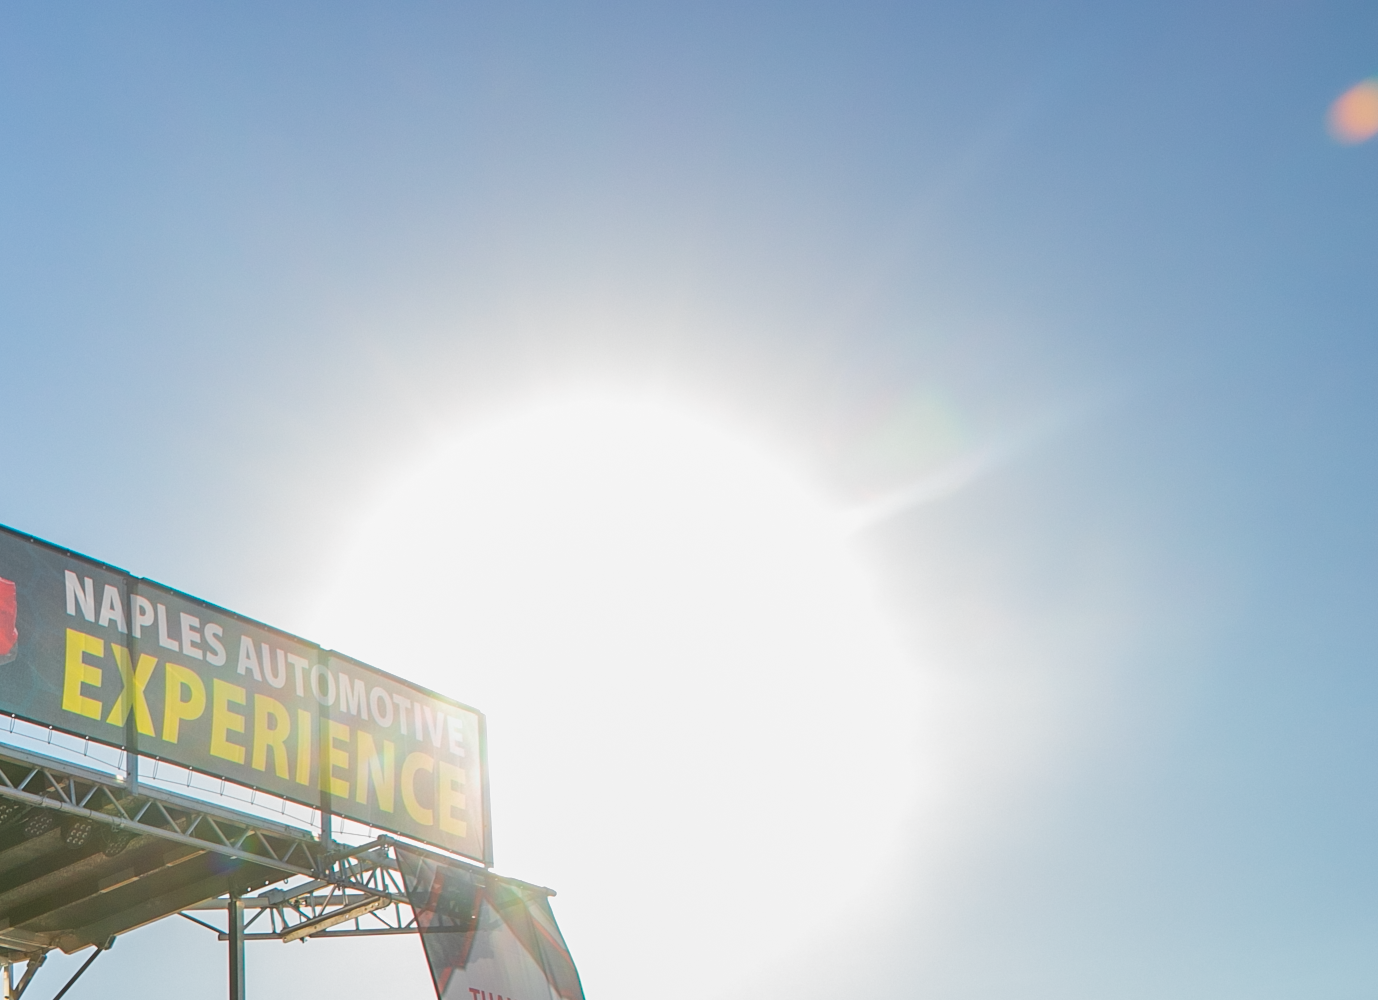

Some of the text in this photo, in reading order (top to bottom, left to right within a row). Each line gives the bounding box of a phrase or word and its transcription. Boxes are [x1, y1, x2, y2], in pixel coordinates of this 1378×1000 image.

[61, 627, 468, 838] EXPERIENCE
[63, 569, 466, 758] NAPLES AUTOMOTIVE
